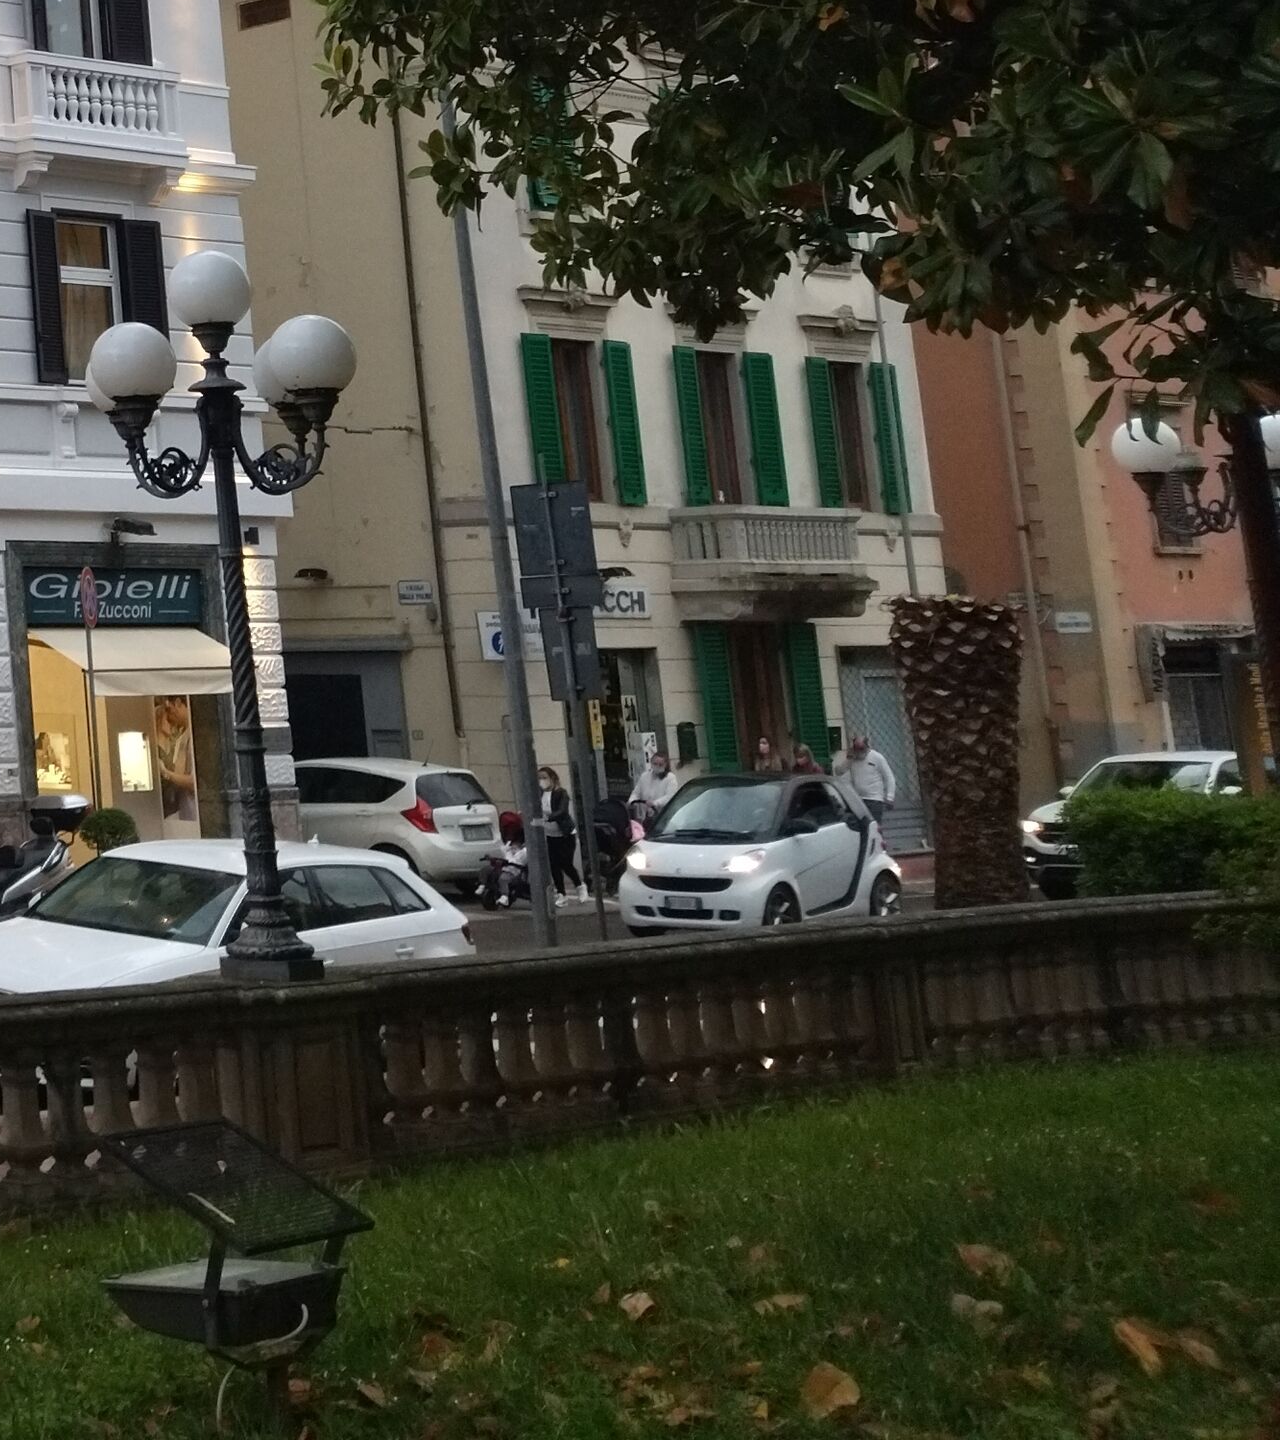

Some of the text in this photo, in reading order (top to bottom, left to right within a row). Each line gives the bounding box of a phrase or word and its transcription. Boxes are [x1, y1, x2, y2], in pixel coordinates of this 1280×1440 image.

[29, 573, 191, 599] Gioielli
[99, 601, 152, 618] Zucconi
[599, 590, 646, 614] CCHI
